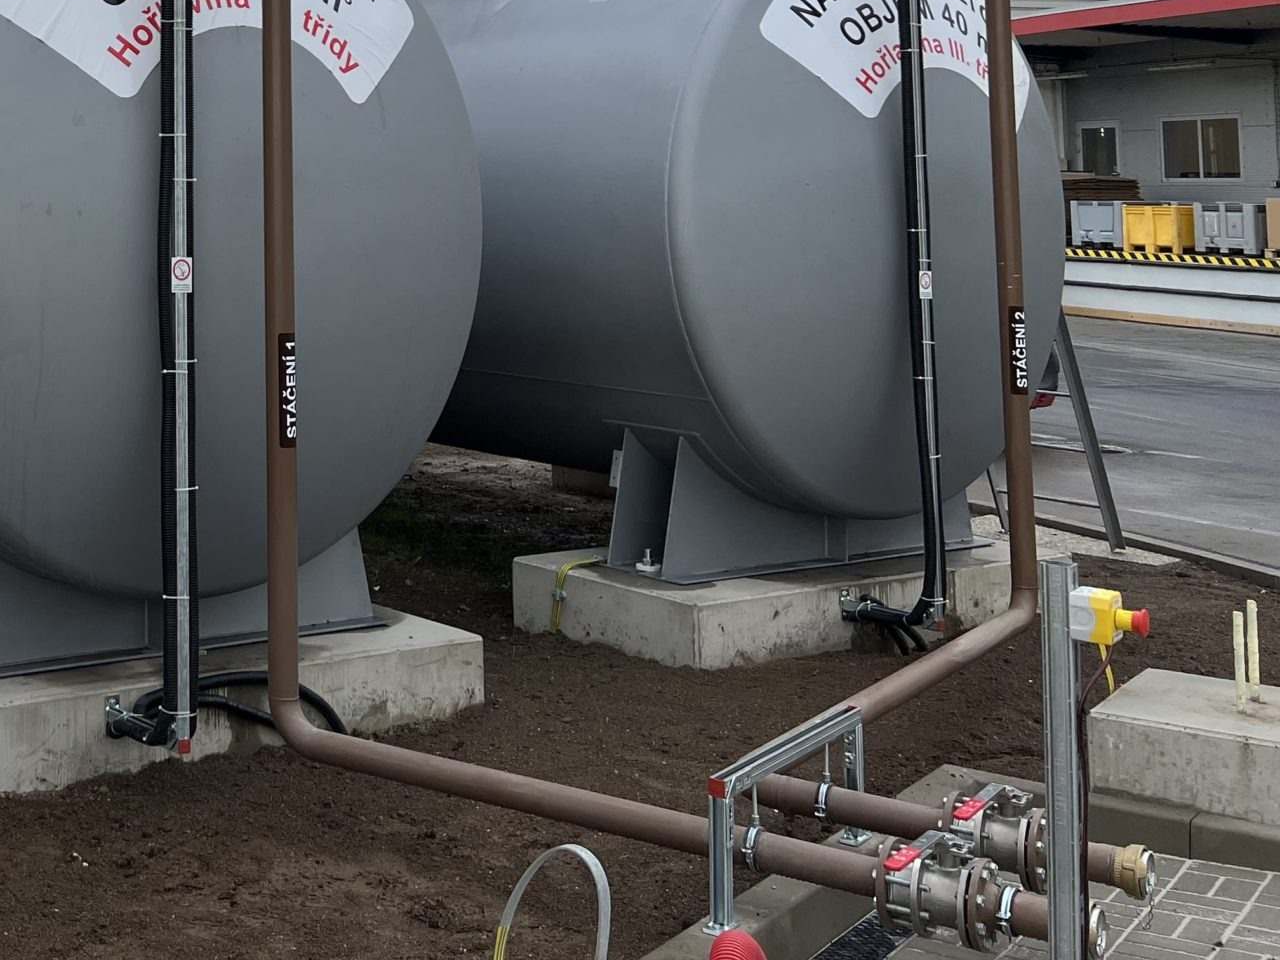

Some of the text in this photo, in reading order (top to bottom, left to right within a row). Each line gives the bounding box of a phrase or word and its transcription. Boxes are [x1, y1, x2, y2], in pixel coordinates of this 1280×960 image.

[303, 9, 360, 75] třídy
[941, 3, 968, 36] 40
[855, 37, 945, 94] Hořlana
[948, 38, 970, 67] III.
[1011, 311, 1028, 388] STÁČENÍ 2
[282, 341, 296, 438] STÁČENÍ 1
